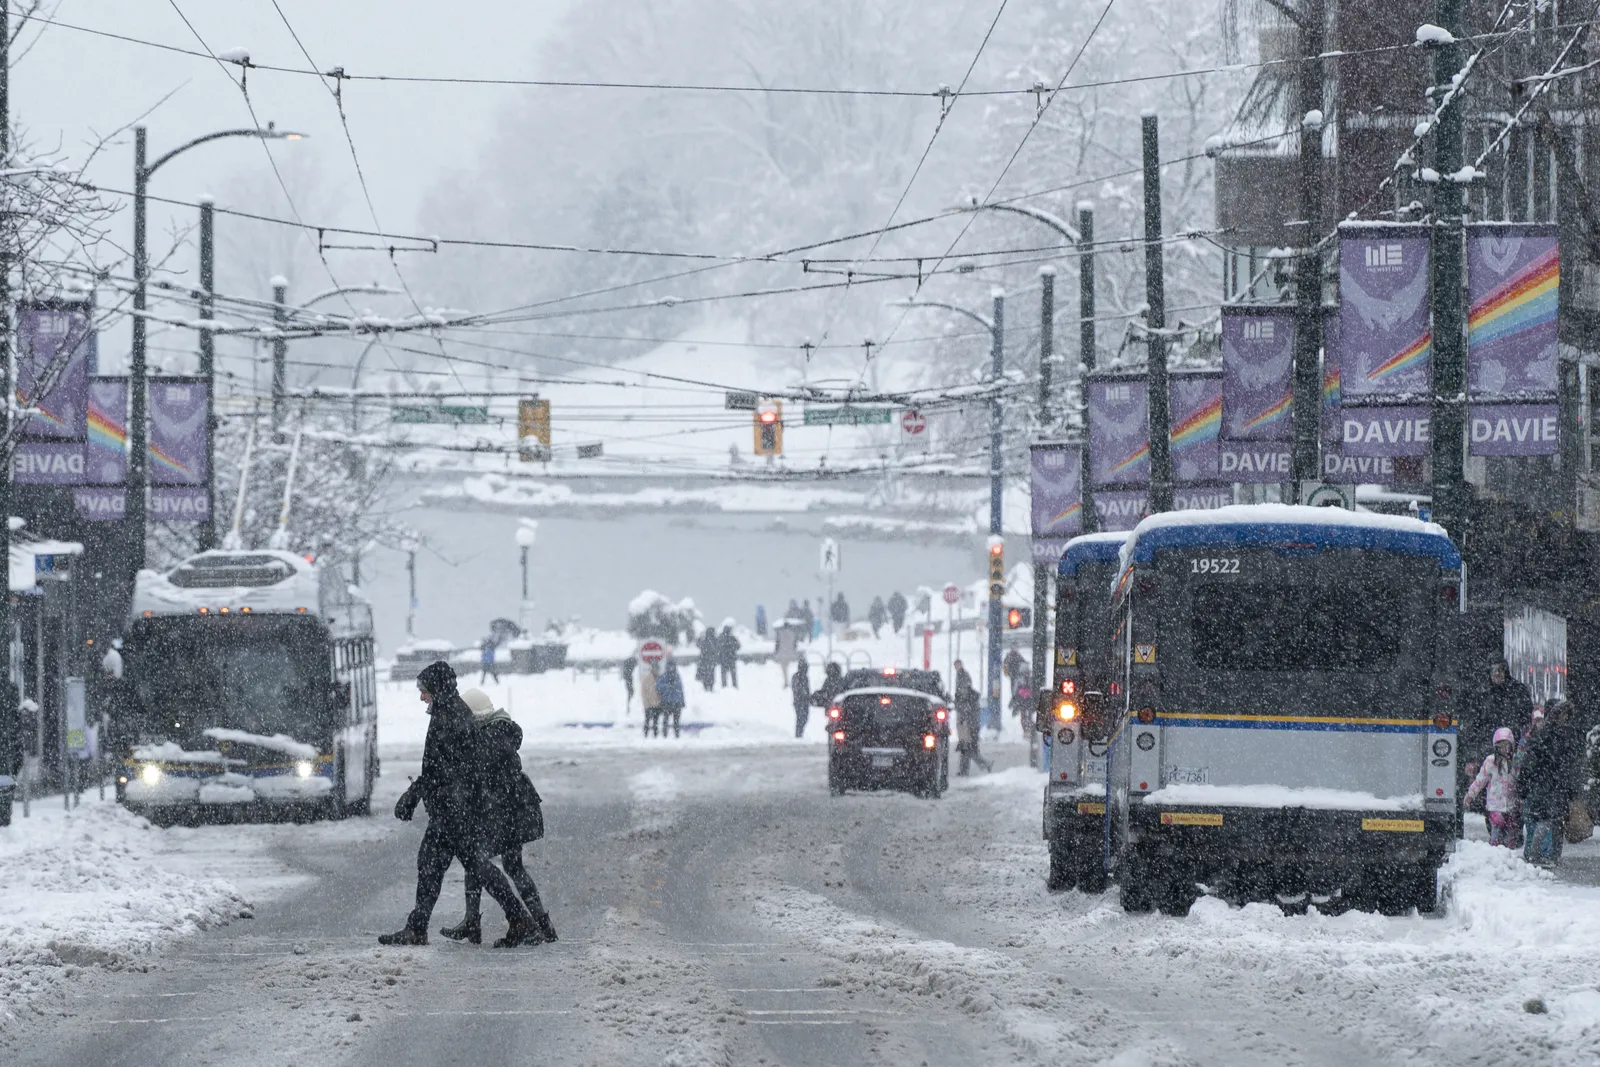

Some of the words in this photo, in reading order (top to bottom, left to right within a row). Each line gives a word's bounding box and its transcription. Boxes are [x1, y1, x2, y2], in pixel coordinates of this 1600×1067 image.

[1343, 419, 1430, 443] DAVIE
[1472, 417, 1557, 442] DAVIE
[1221, 452, 1291, 473] DAVIE
[1324, 454, 1393, 474] DAVIE
[1190, 558, 1240, 574] 19522
